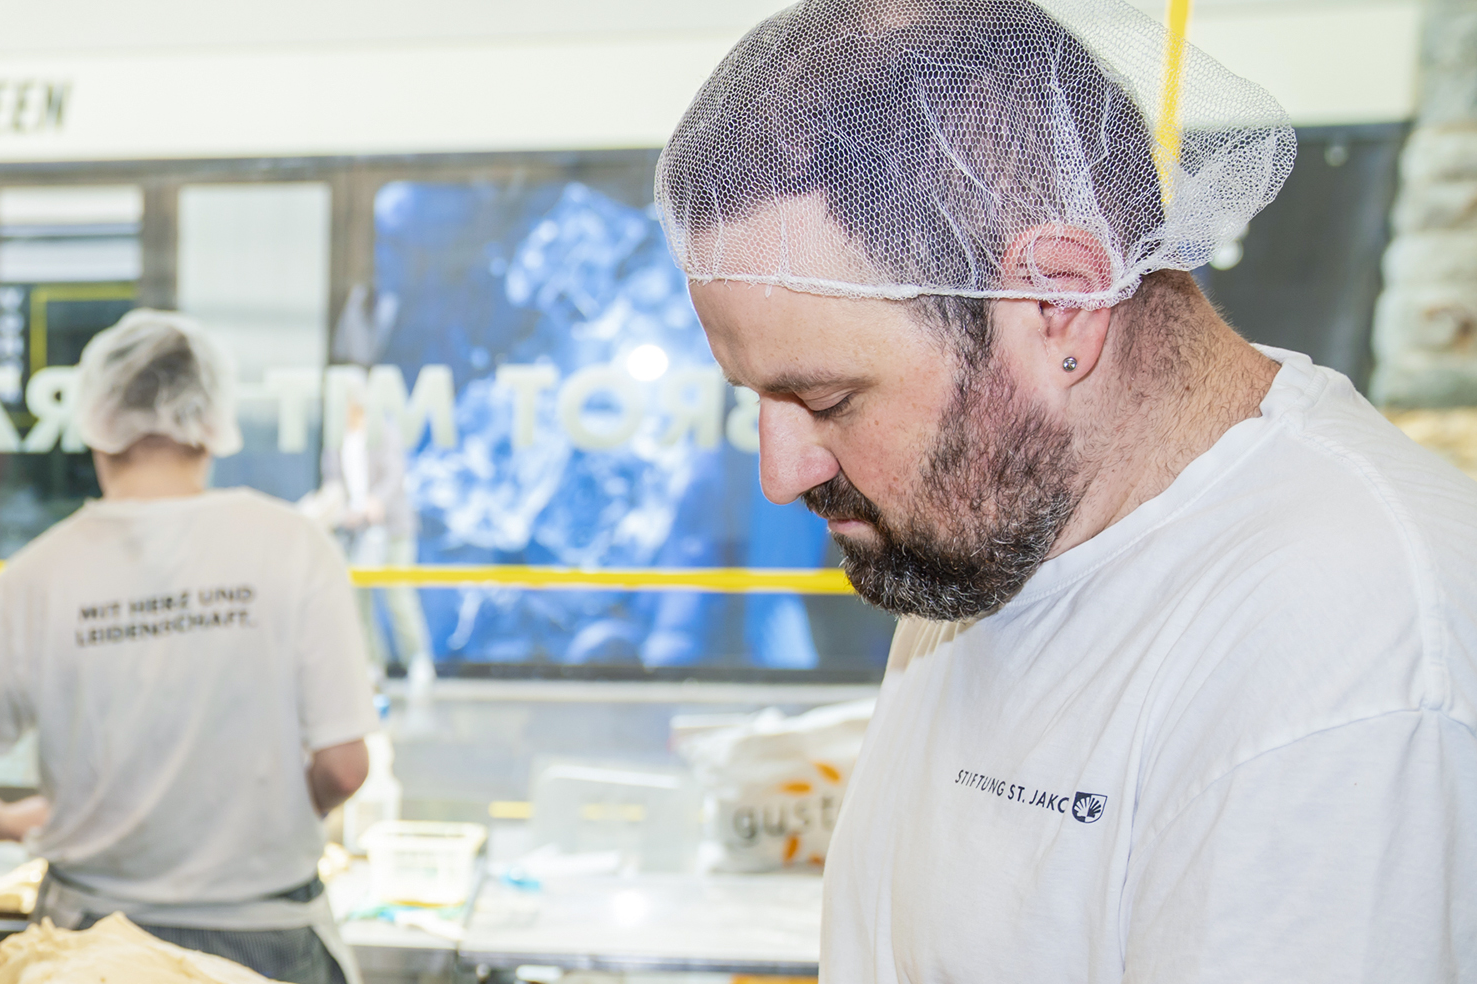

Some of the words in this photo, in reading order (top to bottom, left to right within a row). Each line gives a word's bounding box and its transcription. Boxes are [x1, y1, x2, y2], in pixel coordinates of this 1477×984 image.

[198, 586, 255, 606] UND
[954, 769, 1006, 797] STIFTUNG
[1007, 784, 1025, 803] ST.
